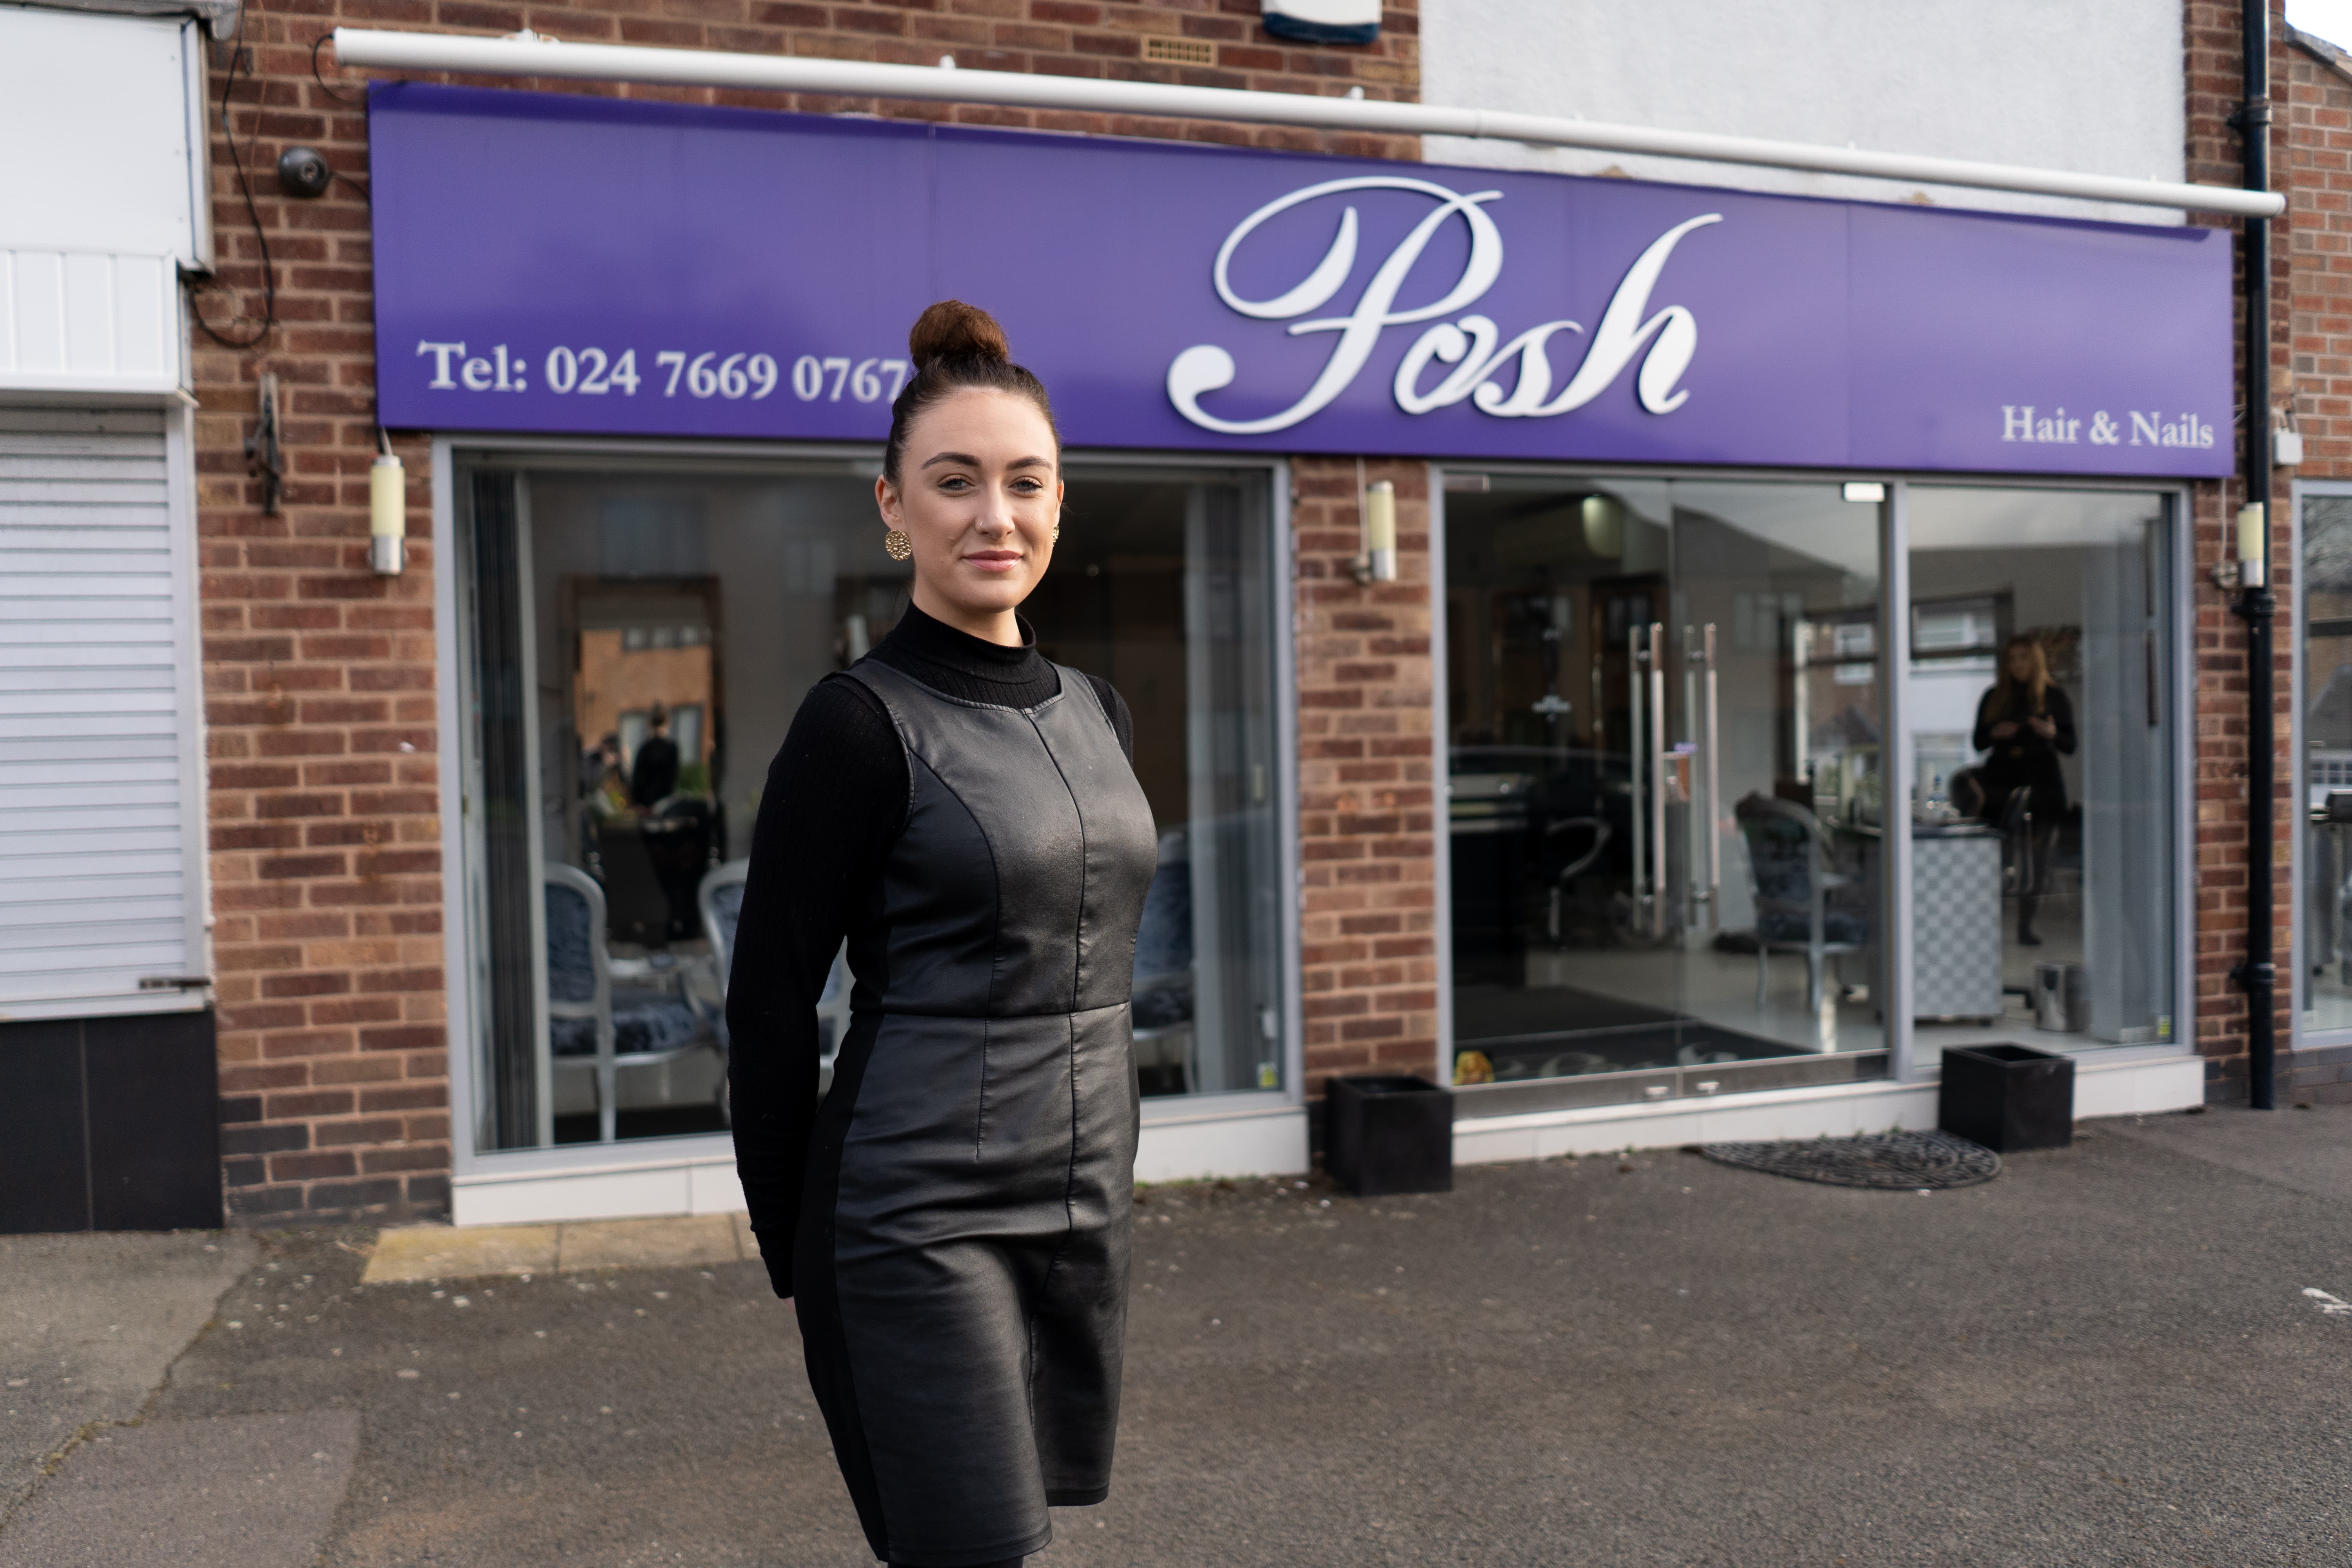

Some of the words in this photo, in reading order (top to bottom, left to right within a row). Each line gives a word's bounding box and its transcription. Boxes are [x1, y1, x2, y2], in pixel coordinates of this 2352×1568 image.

[1167, 176, 1723, 434] Posh
[416, 340, 527, 391] Tel:
[545, 346, 641, 395] 024
[656, 350, 778, 399] 7669
[792, 355, 908, 404] 0767
[2002, 405, 2081, 443] Hair
[2089, 410, 2119, 445] &
[2129, 410, 2214, 449] Nails
